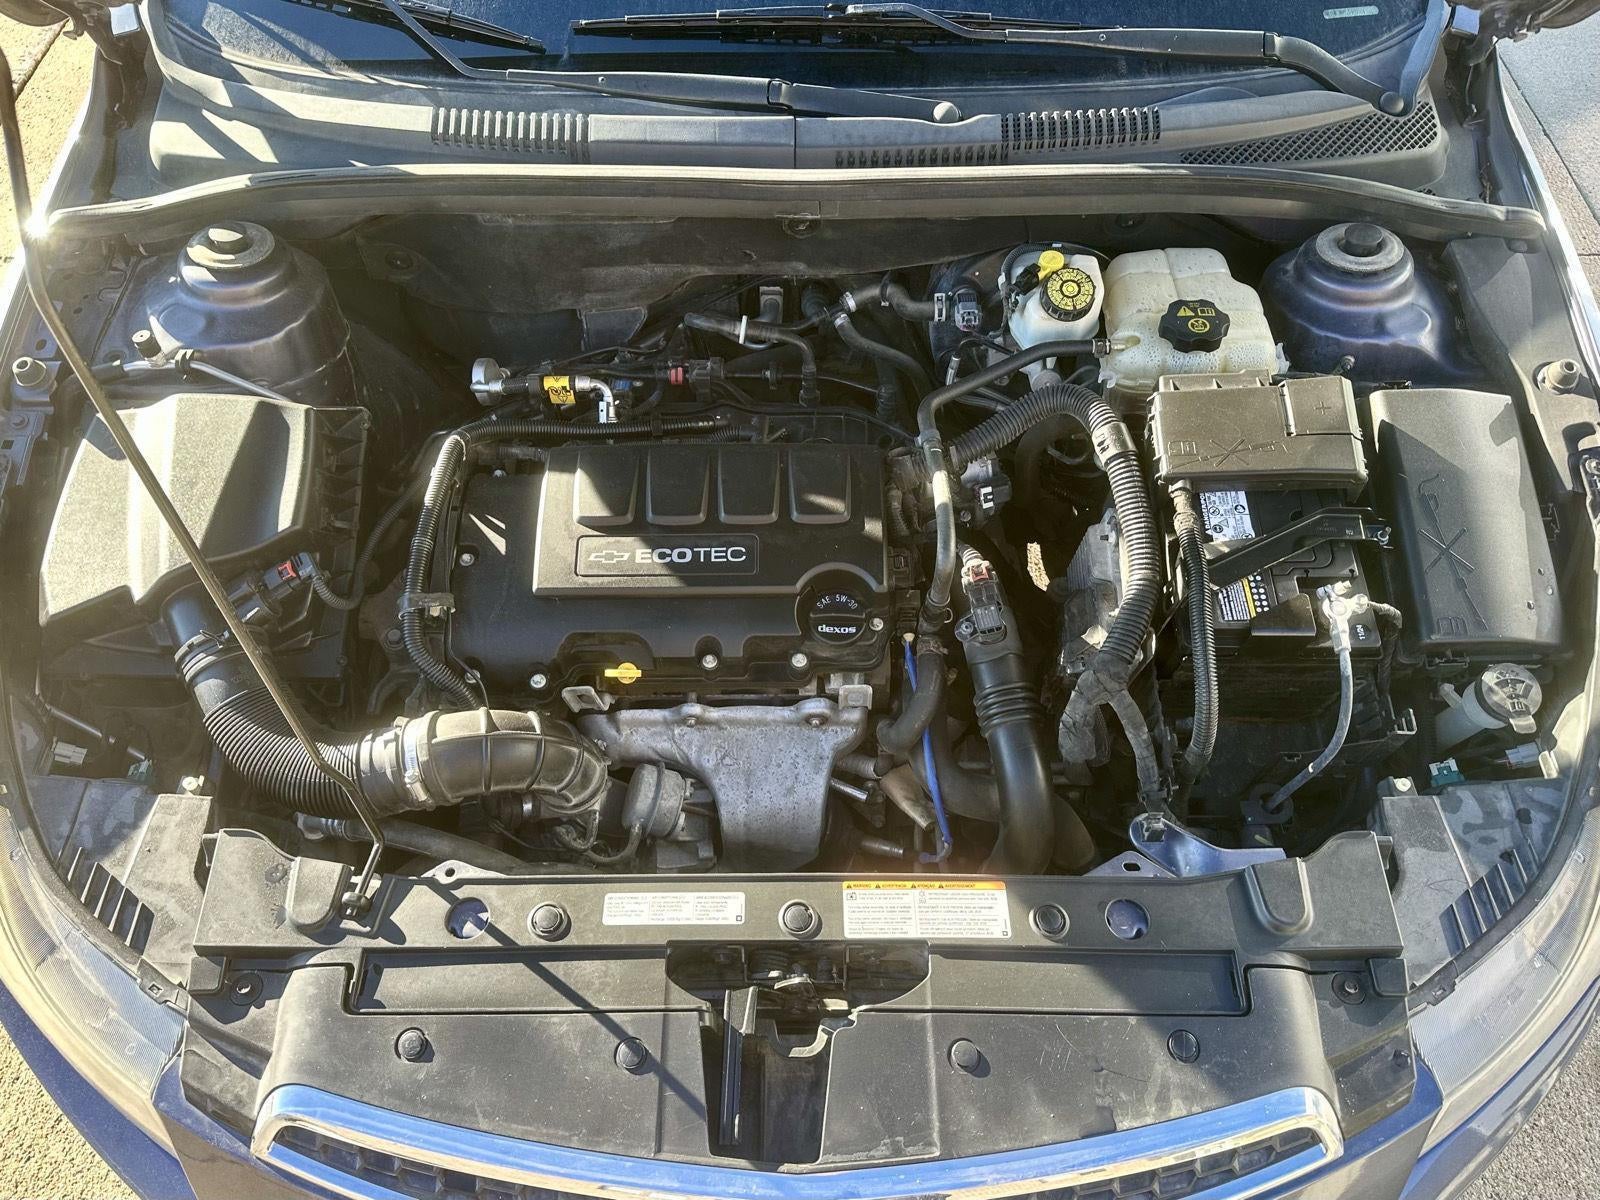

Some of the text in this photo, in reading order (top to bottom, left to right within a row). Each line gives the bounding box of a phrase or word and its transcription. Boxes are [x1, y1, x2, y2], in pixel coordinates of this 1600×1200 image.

[635, 546, 747, 564] ECOTEC
[816, 593, 858, 610] SAE 5W-30
[817, 624, 857, 634] dexos
